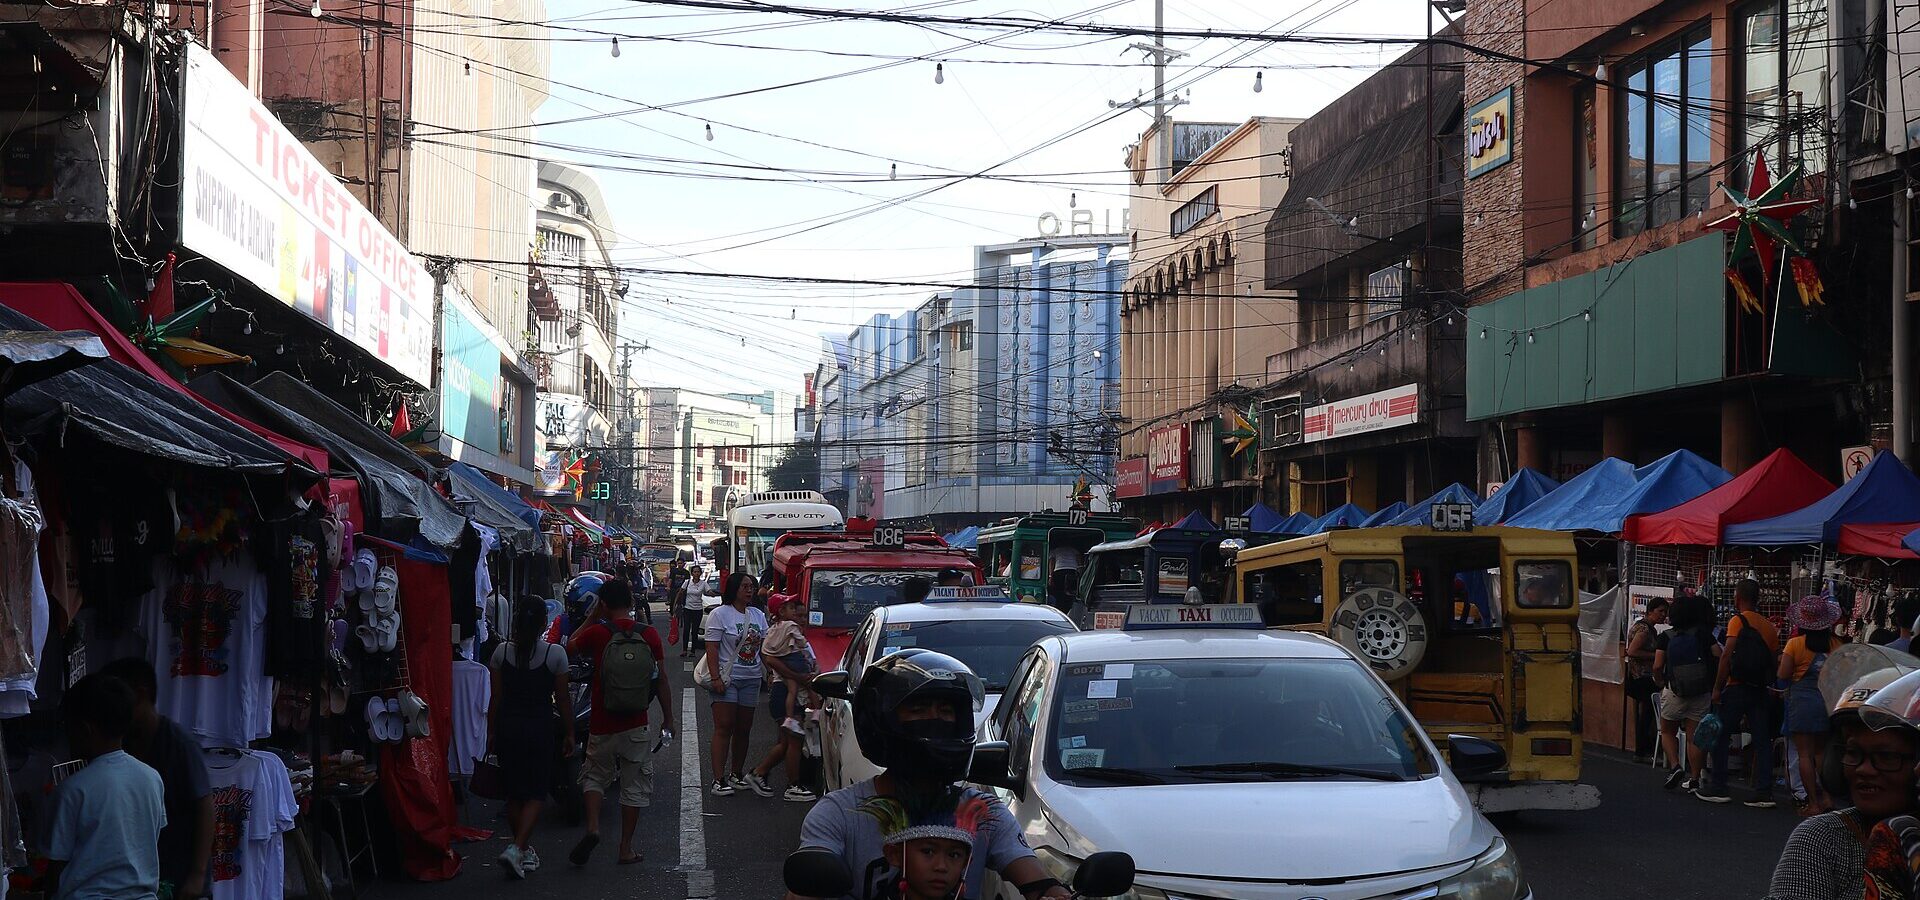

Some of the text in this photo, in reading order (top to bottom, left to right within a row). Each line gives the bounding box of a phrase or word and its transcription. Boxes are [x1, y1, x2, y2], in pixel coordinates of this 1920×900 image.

[250, 106, 351, 239] TICKET
[358, 216, 417, 301] OFFICE
[195, 165, 237, 242] SHIPPING
[239, 199, 245, 249] &
[247, 204, 275, 268] AIRLINE
[1334, 397, 1388, 424] mercury drug
[1156, 465, 1181, 478] PAWNSHOP
[776, 512, 801, 520] CEBU
[802, 512, 826, 520] CITY
[1069, 510, 1087, 525] 17B
[1224, 516, 1250, 531] 12C
[1432, 504, 1472, 529] 06F
[873, 527, 904, 546] 08G
[934, 587, 1000, 598] VACANT TAXI OCCUPIED
[1139, 607, 1254, 623] VACANT TAXI OCCUPIED
